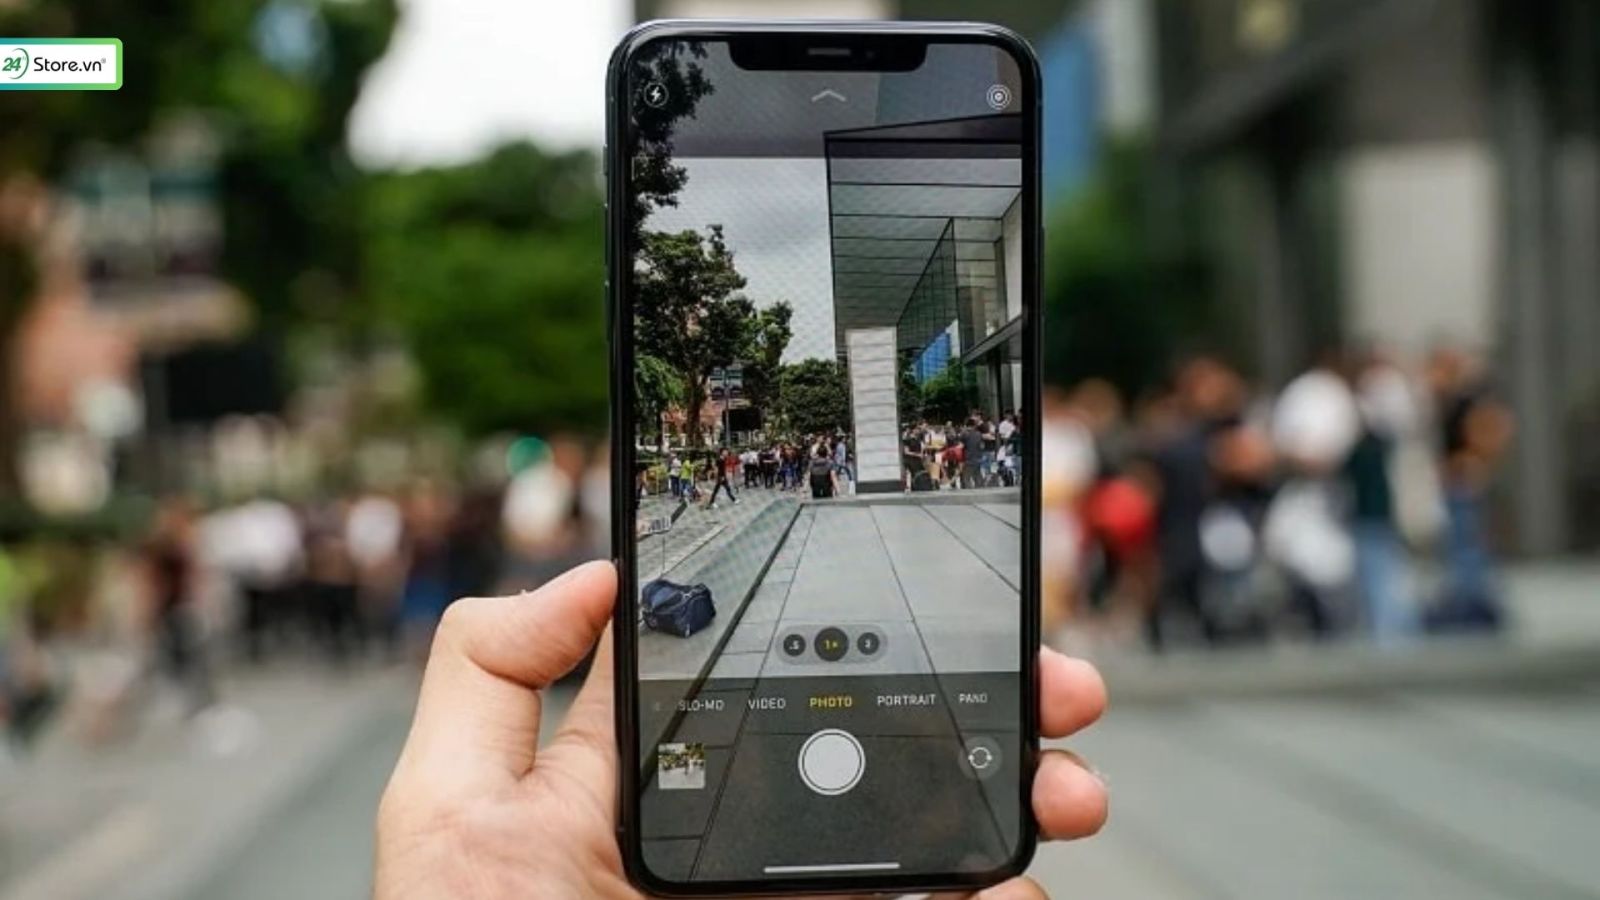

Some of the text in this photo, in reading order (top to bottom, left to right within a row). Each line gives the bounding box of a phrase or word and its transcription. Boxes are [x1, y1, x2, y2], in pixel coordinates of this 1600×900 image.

[678, 693, 988, 711] SLO-MO VIDEO PHOTO PORTRAIT PANO
